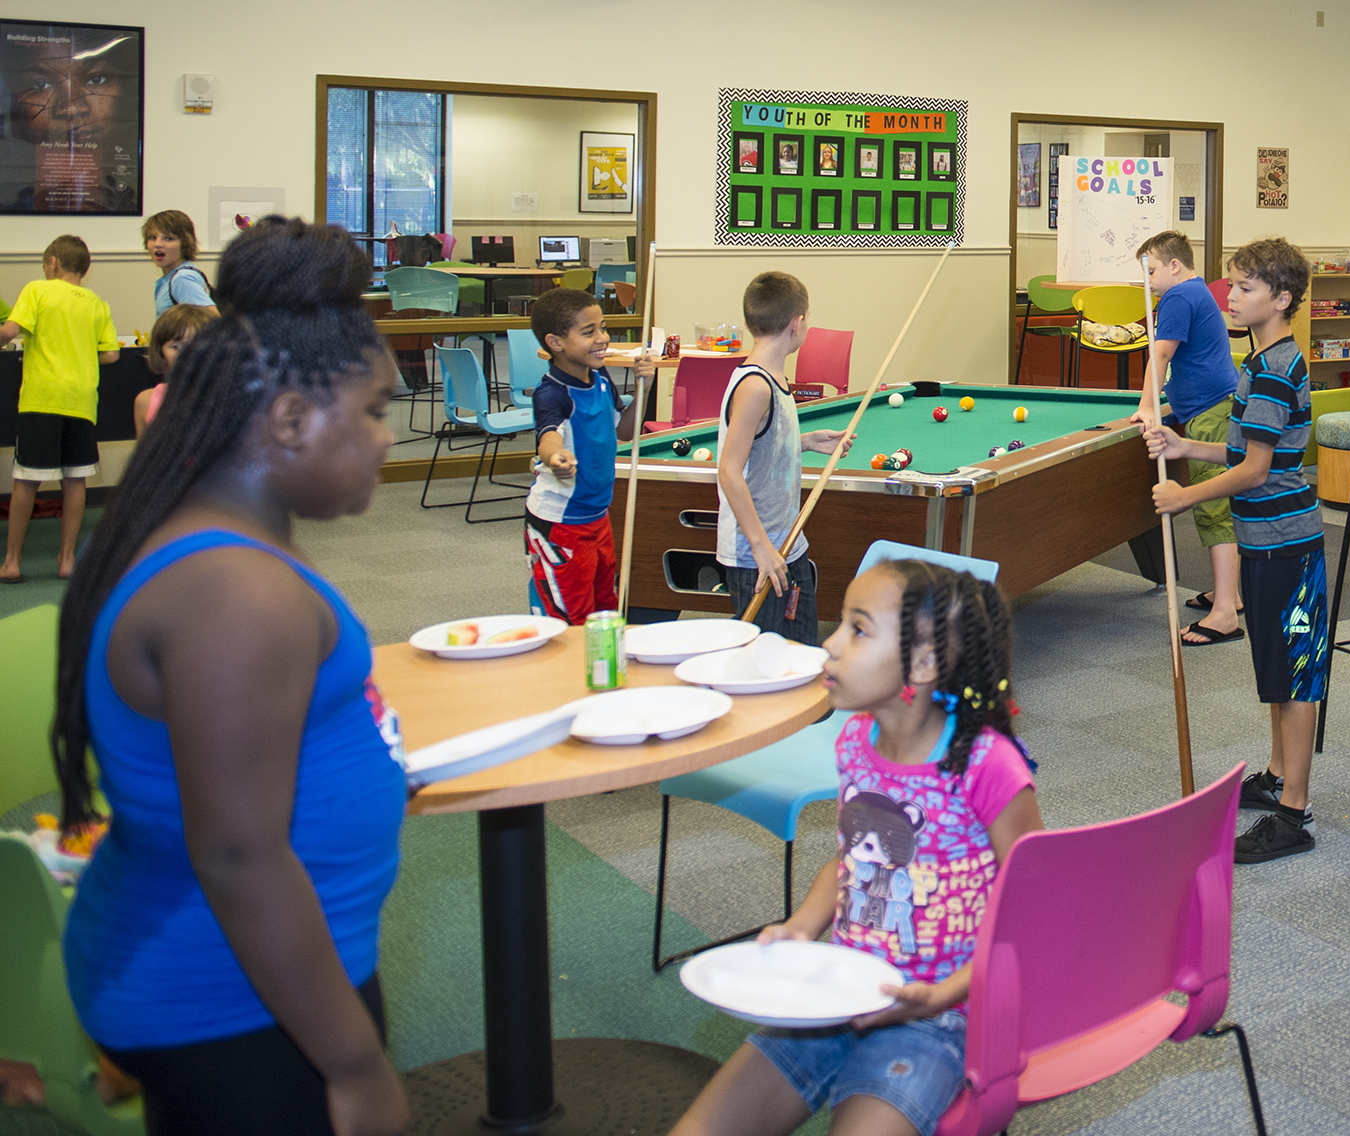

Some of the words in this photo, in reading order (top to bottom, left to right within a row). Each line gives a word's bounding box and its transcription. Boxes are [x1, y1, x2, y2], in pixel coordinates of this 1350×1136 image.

[7, 34, 36, 42] Building
[37, 36, 71, 44] Strengths
[743, 105, 806, 126] YOUTH
[814, 112, 831, 126] OF
[845, 114, 871, 128] THE
[883, 115, 942, 130] MONTH
[84, 141, 98, 150] Help
[1076, 157, 1164, 177] SCHOOL
[1076, 175, 1152, 196] GOALS
[1265, 190, 1282, 199] HOT
